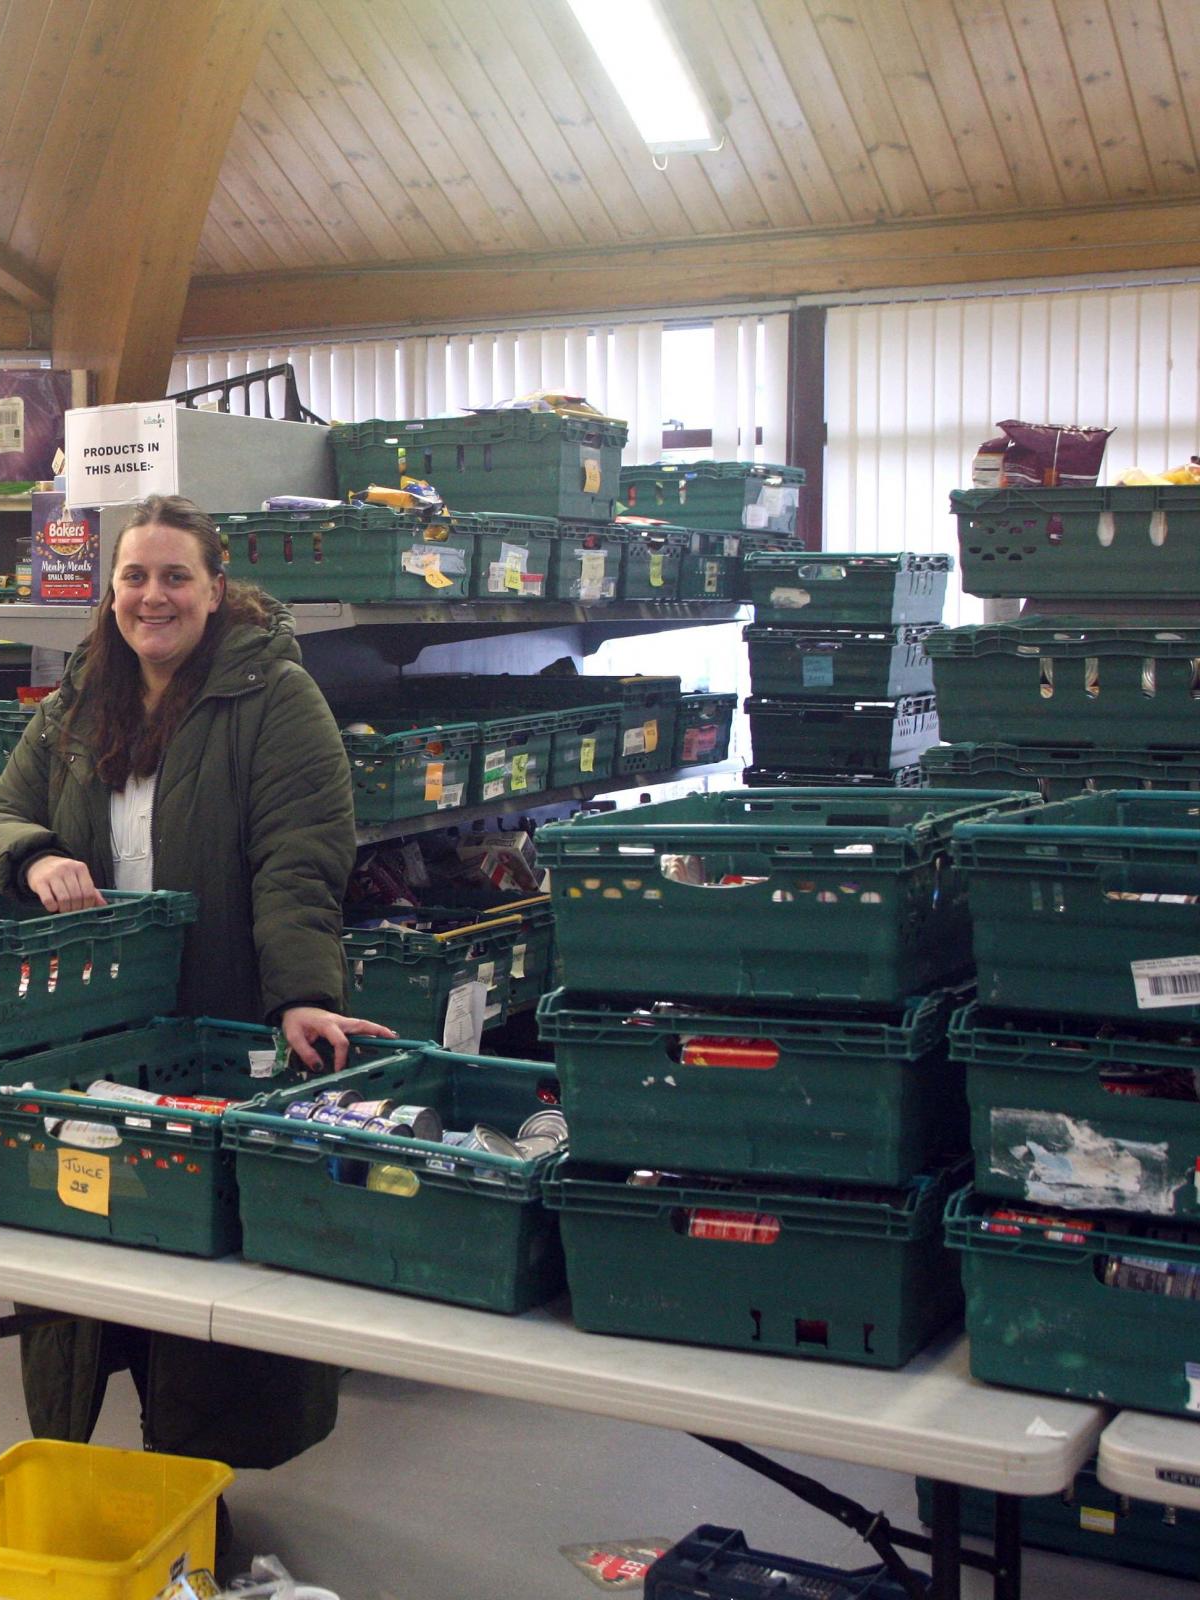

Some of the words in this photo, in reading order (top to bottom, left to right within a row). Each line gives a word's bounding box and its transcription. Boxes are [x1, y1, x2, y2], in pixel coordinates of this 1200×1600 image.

[83, 443, 144, 458] PRODUCTS
[148, 442, 160, 452] IN
[85, 464, 111, 476] THIS
[48, 522, 85, 537] Bakers
[41, 560, 66, 573] Meaty
[67, 560, 92, 572] Meals
[47, 573, 63, 581] SMALL
[61, 1157, 104, 1179] JUICE
